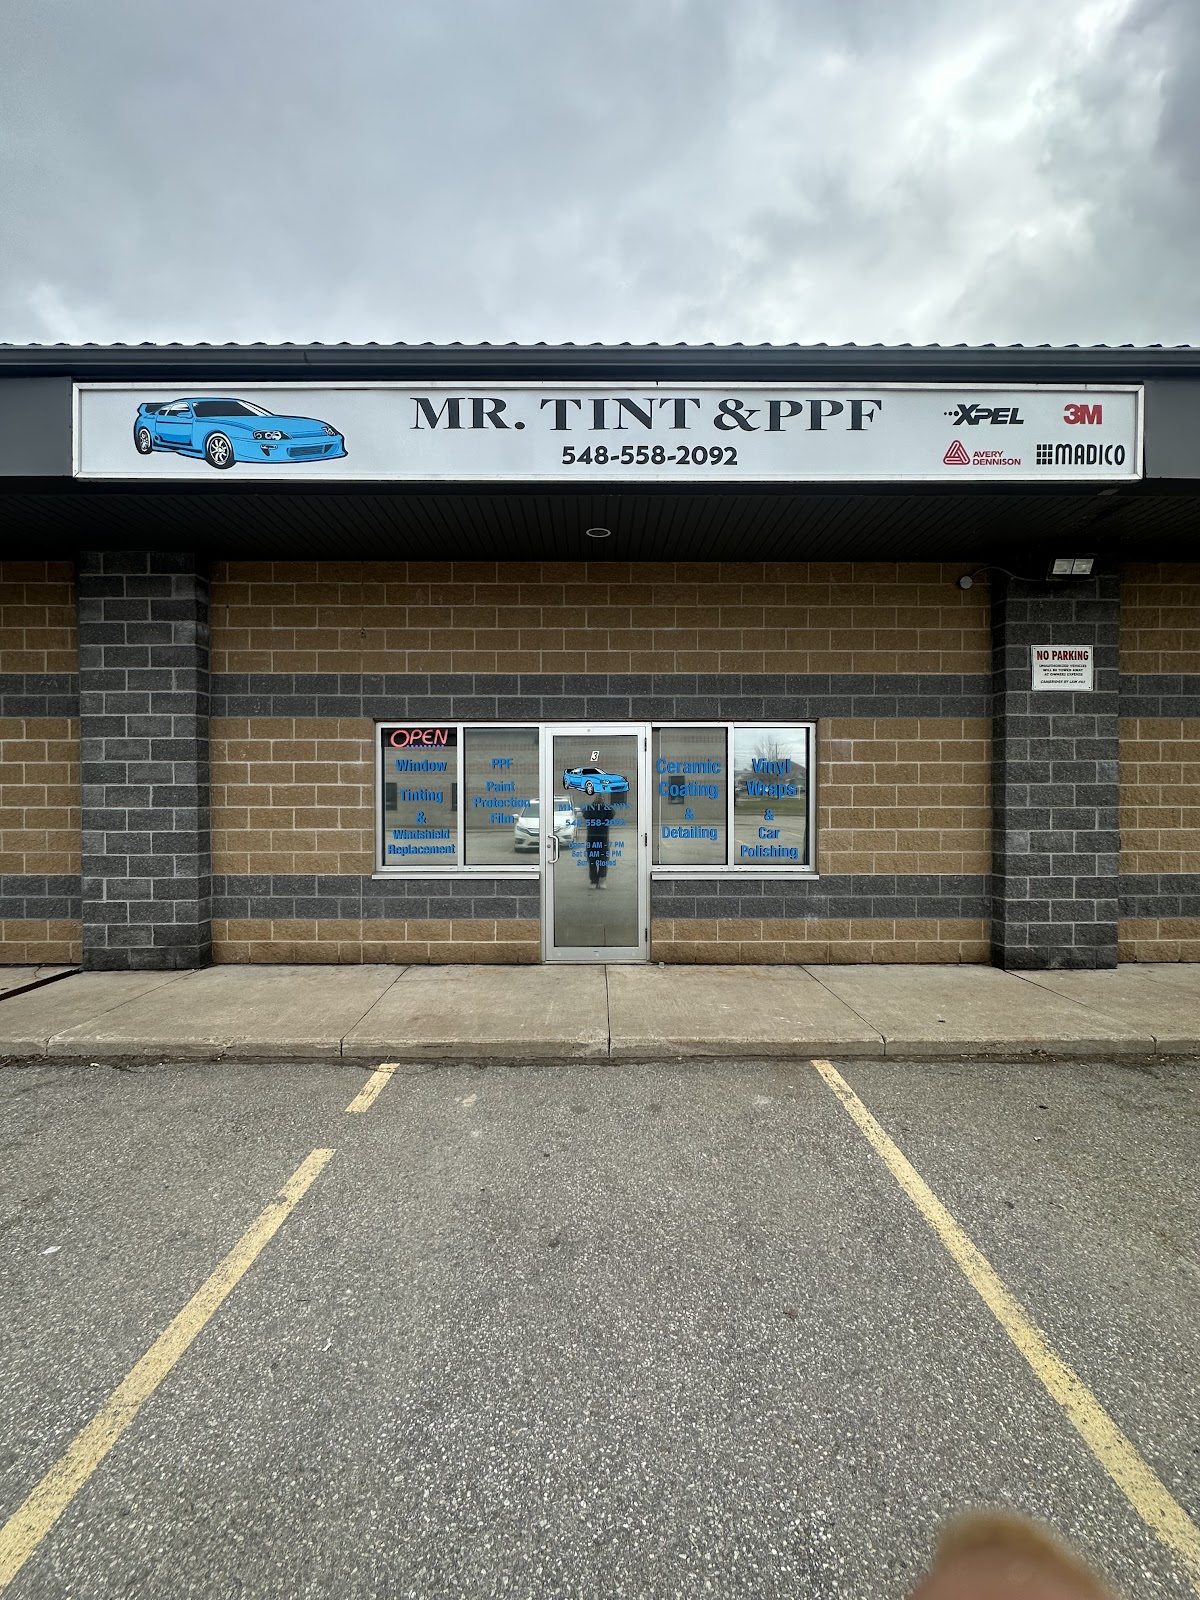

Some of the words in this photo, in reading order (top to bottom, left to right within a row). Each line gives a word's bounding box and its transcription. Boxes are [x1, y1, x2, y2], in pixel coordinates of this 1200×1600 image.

[410, 398, 526, 431] MR.
[540, 398, 702, 431] TINT
[953, 403, 1025, 426] XPEL
[1063, 403, 1103, 425] 3M
[562, 445, 738, 467] 548-558-2092
[973, 450, 1004, 458] AVERY
[1055, 443, 1126, 466] MADICO
[972, 458, 1022, 466] DENNISON
[1037, 650, 1049, 660] NO
[1052, 650, 1089, 660] PARKING
[390, 729, 449, 748] OPEN
[592, 751, 599, 761] 3
[395, 759, 448, 772] Window
[491, 757, 513, 769] PPF
[656, 758, 722, 775] Ceramic
[751, 758, 791, 777] Vinyl
[486, 781, 515, 792] Paint
[658, 780, 719, 801] Coating
[746, 780, 797, 801] Wraps
[399, 789, 444, 803] Tinting
[473, 796, 531, 808] Protection
[603, 803, 612, 811] &
[415, 811, 427, 824] &
[490, 812, 515, 824] Film
[684, 807, 695, 821] &
[763, 808, 775, 821] &
[393, 829, 450, 840] Windshield
[661, 825, 718, 841] Detailing
[758, 826, 781, 840] Car
[387, 843, 456, 856] Replacement
[592, 841, 603, 849] AM
[589, 850, 600, 858] AM
[740, 844, 799, 860] Polishing
